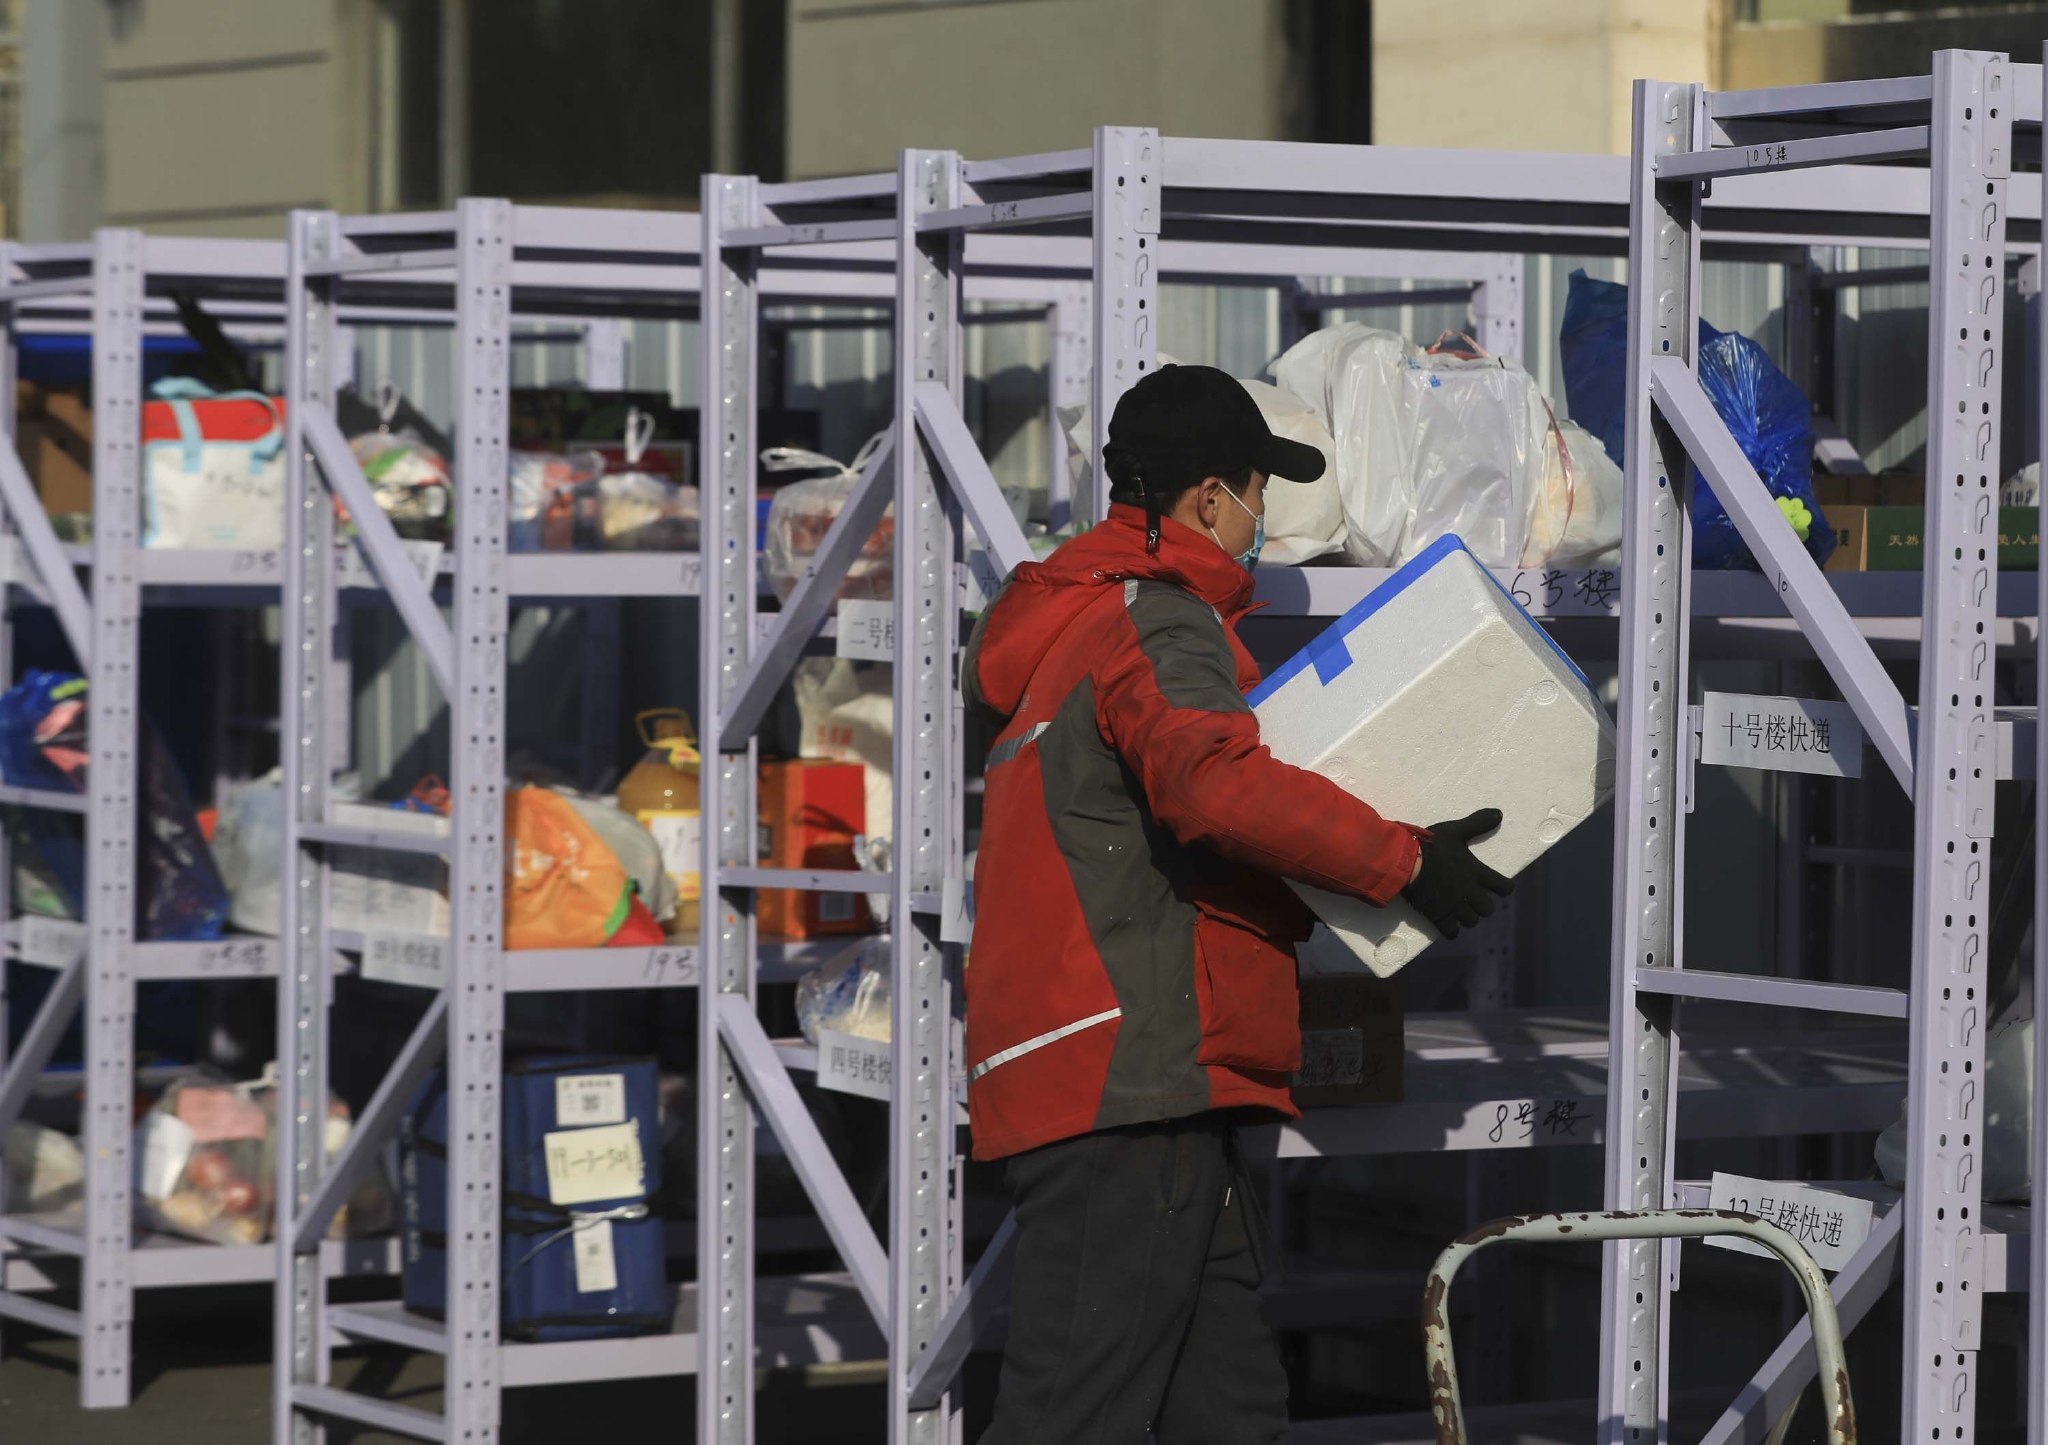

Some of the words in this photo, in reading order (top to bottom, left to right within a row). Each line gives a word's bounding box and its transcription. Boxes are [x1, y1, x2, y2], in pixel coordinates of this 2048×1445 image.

[1511, 568, 1620, 610] 6号楼
[1721, 711, 1832, 754] 十号楼快递
[1488, 1100, 1594, 1143] 8号楼
